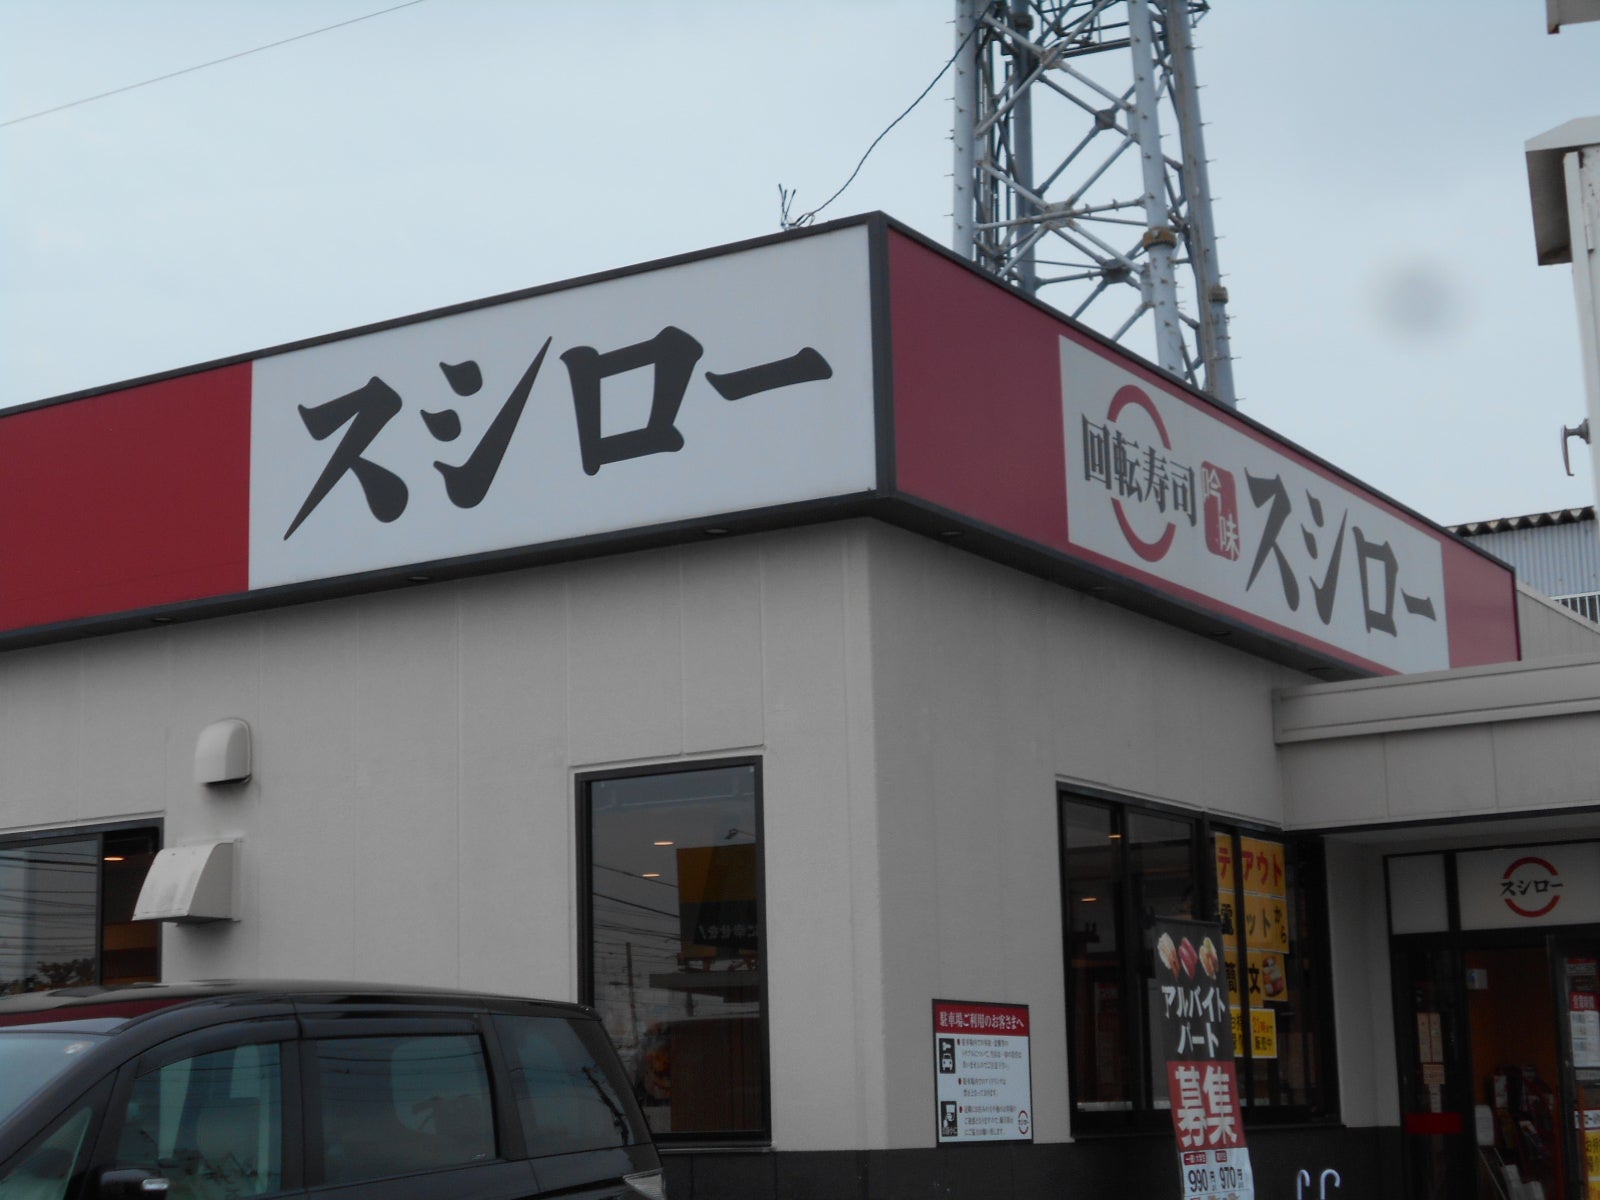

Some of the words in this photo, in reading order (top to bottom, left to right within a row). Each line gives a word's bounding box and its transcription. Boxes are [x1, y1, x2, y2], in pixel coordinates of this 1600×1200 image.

[283, 325, 834, 542] スシロー
[1082, 413, 1197, 528] 回転寿司
[1201, 468, 1240, 561] 吟味
[1244, 466, 1437, 638] スシロー
[1501, 880, 1564, 896] スシロー
[940, 1011, 1025, 1030] 駐車場ご利用のお客さまへ
[1161, 985, 1226, 1023] アルバイト
[1175, 1065, 1238, 1147] 募集
